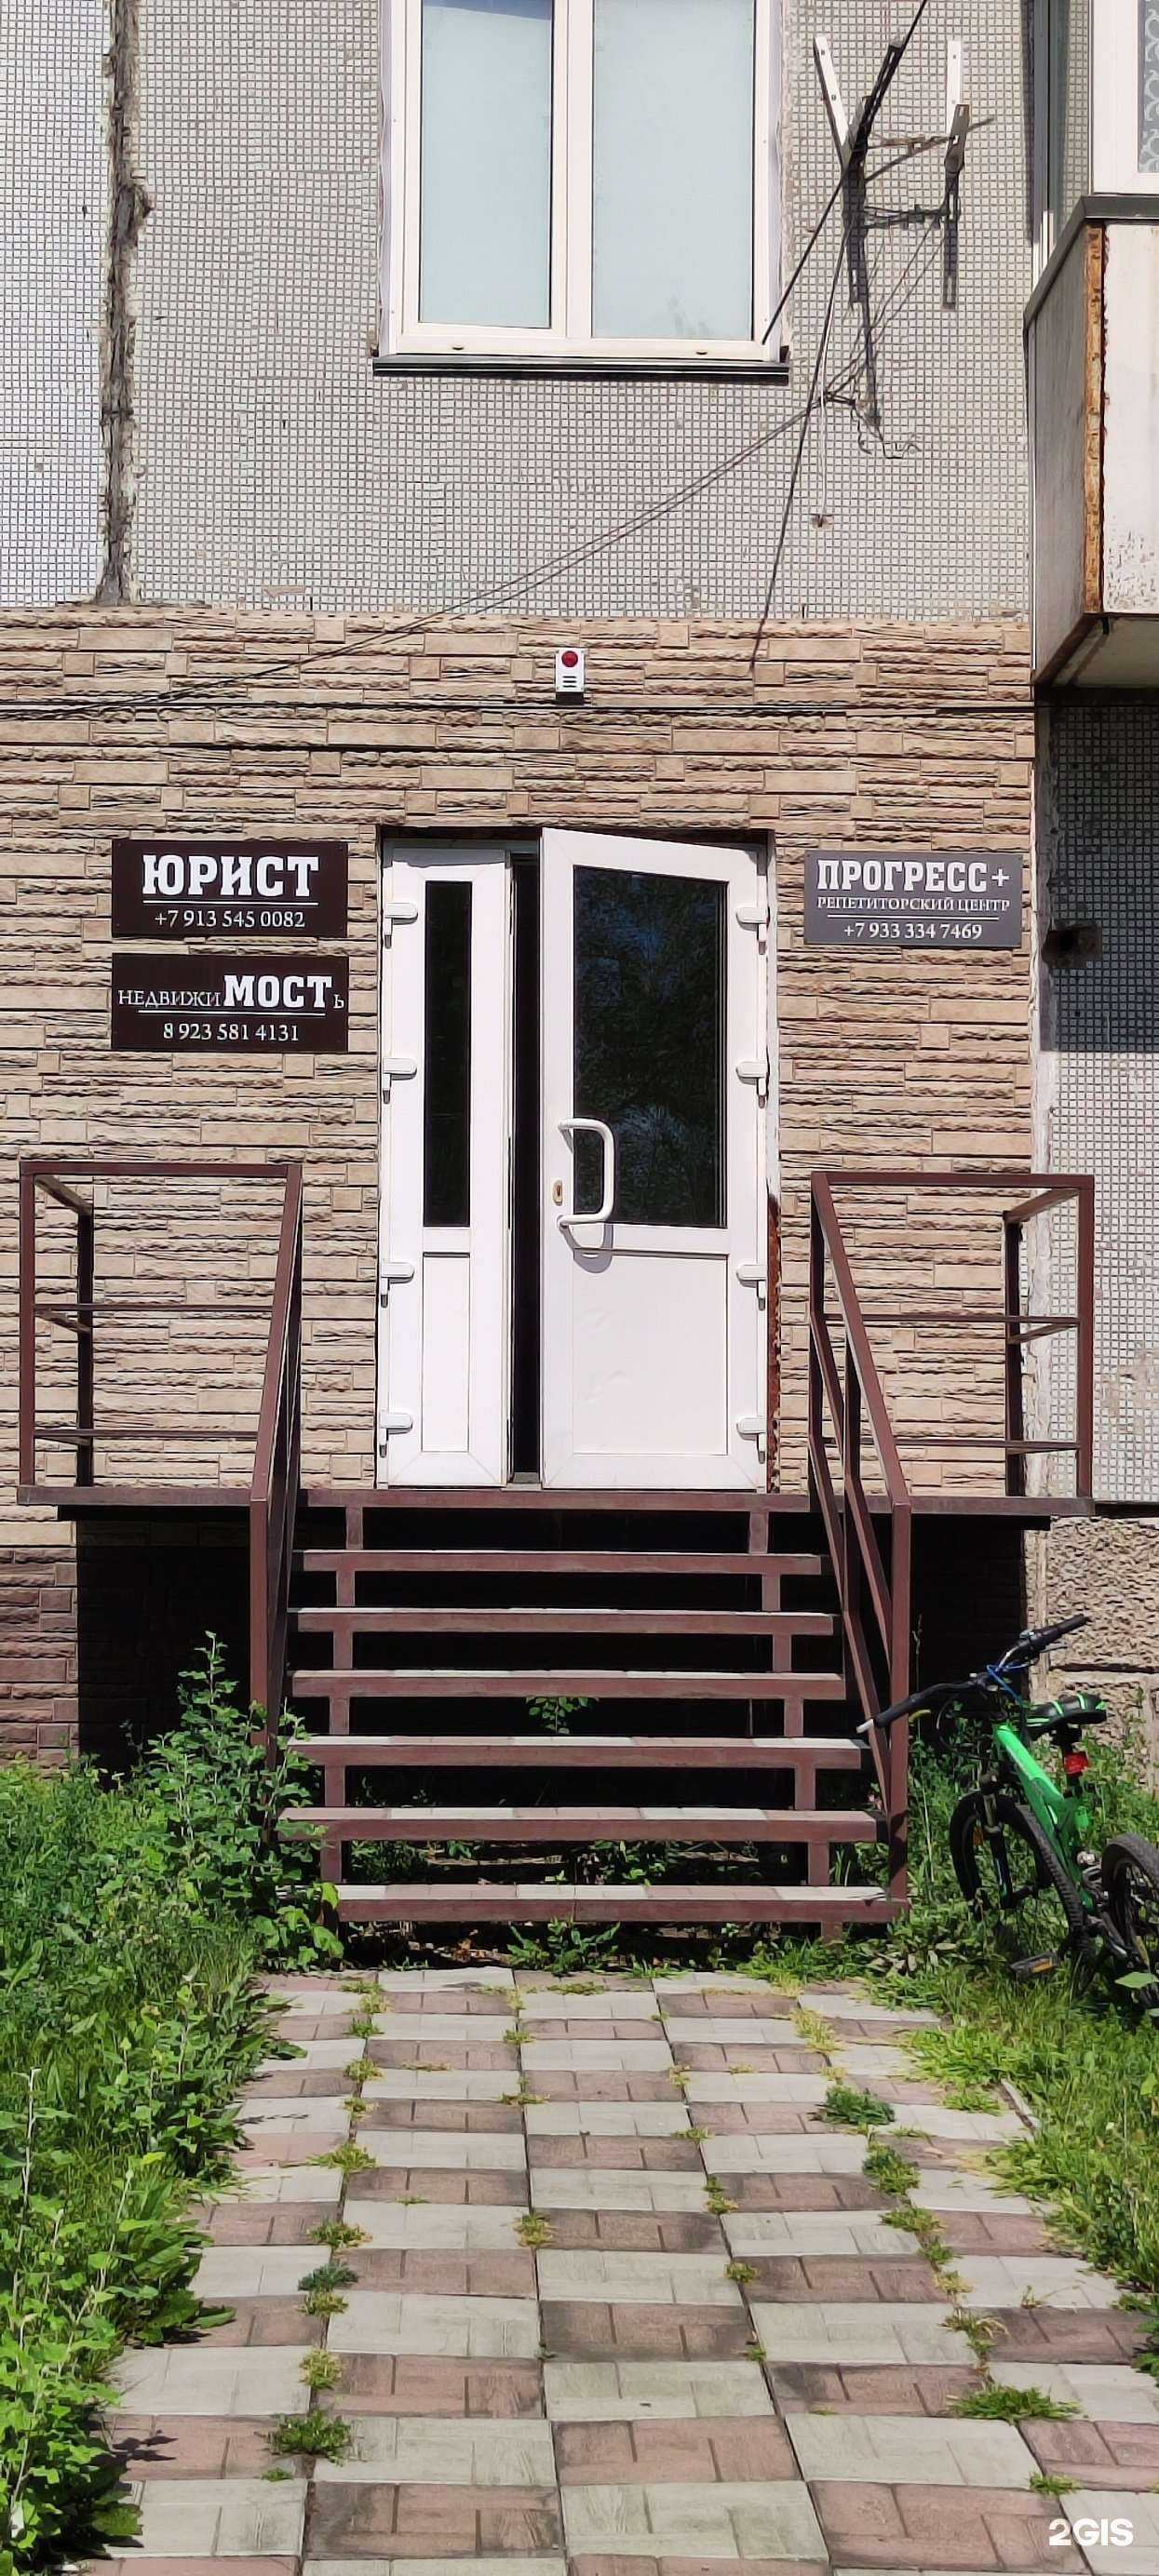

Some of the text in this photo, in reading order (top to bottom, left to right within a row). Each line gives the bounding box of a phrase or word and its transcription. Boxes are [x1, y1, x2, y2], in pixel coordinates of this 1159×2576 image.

[142, 854, 319, 896] ЮРИСТ
[816, 895, 1011, 913] РЕПЕТИТОРСКИЙ ЦЕНТР
[155, 910, 306, 928] +7 913 545 0082
[843, 922, 983, 940] +7 933 334 7469
[163, 1023, 299, 1041] 8 923 581 4131
